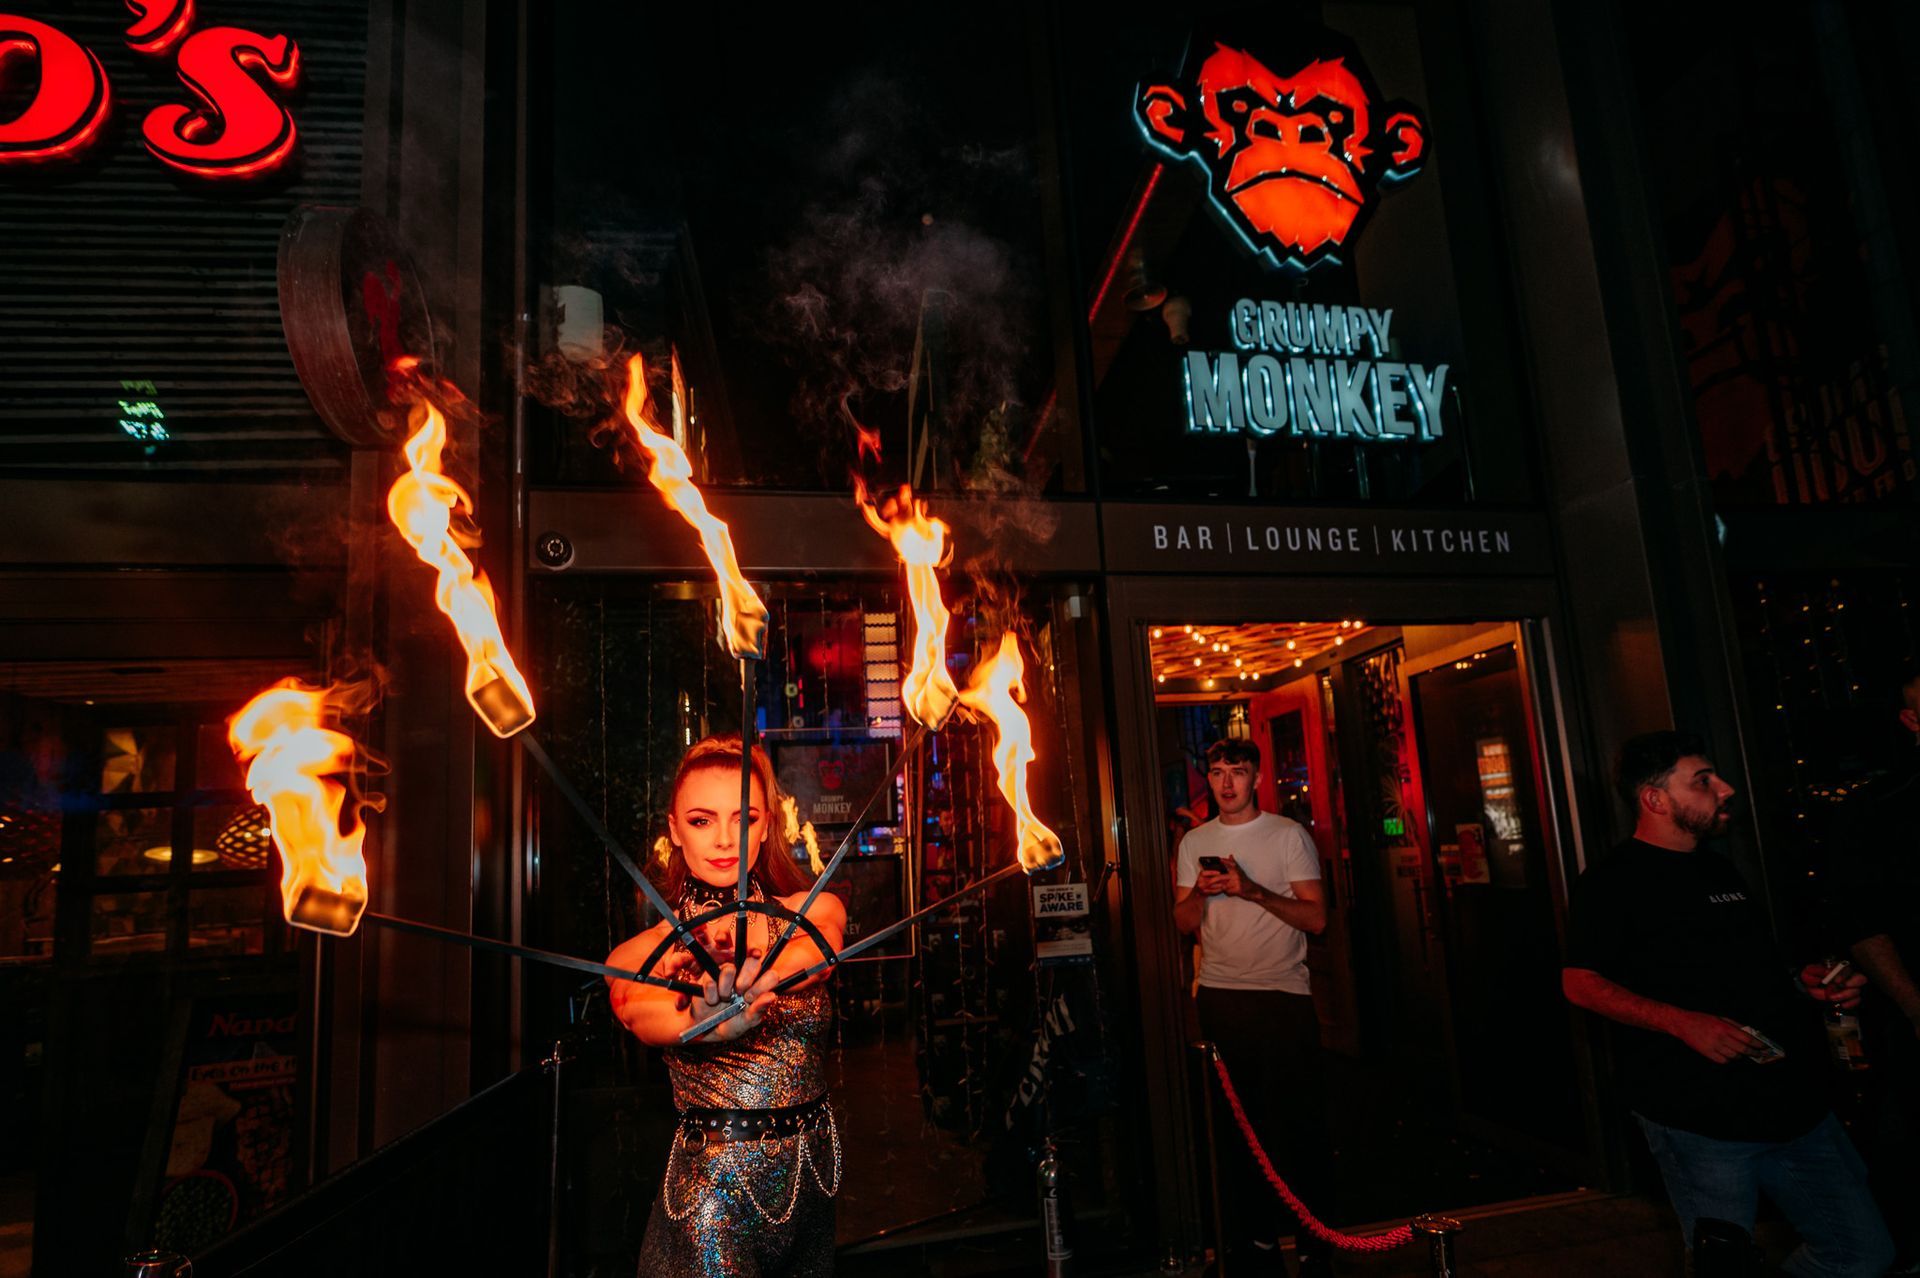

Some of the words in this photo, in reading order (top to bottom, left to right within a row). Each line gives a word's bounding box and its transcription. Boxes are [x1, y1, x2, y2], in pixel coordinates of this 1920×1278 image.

[1231, 297, 1394, 358] GRUMPY
[1183, 350, 1450, 441] MONKEY
[1153, 524, 1214, 551] BAR
[1246, 525, 1361, 551] LOUNGE
[1391, 528, 1512, 553] KITCHEN
[813, 802, 852, 814] MONKEY
[1040, 901, 1084, 913] AWARE
